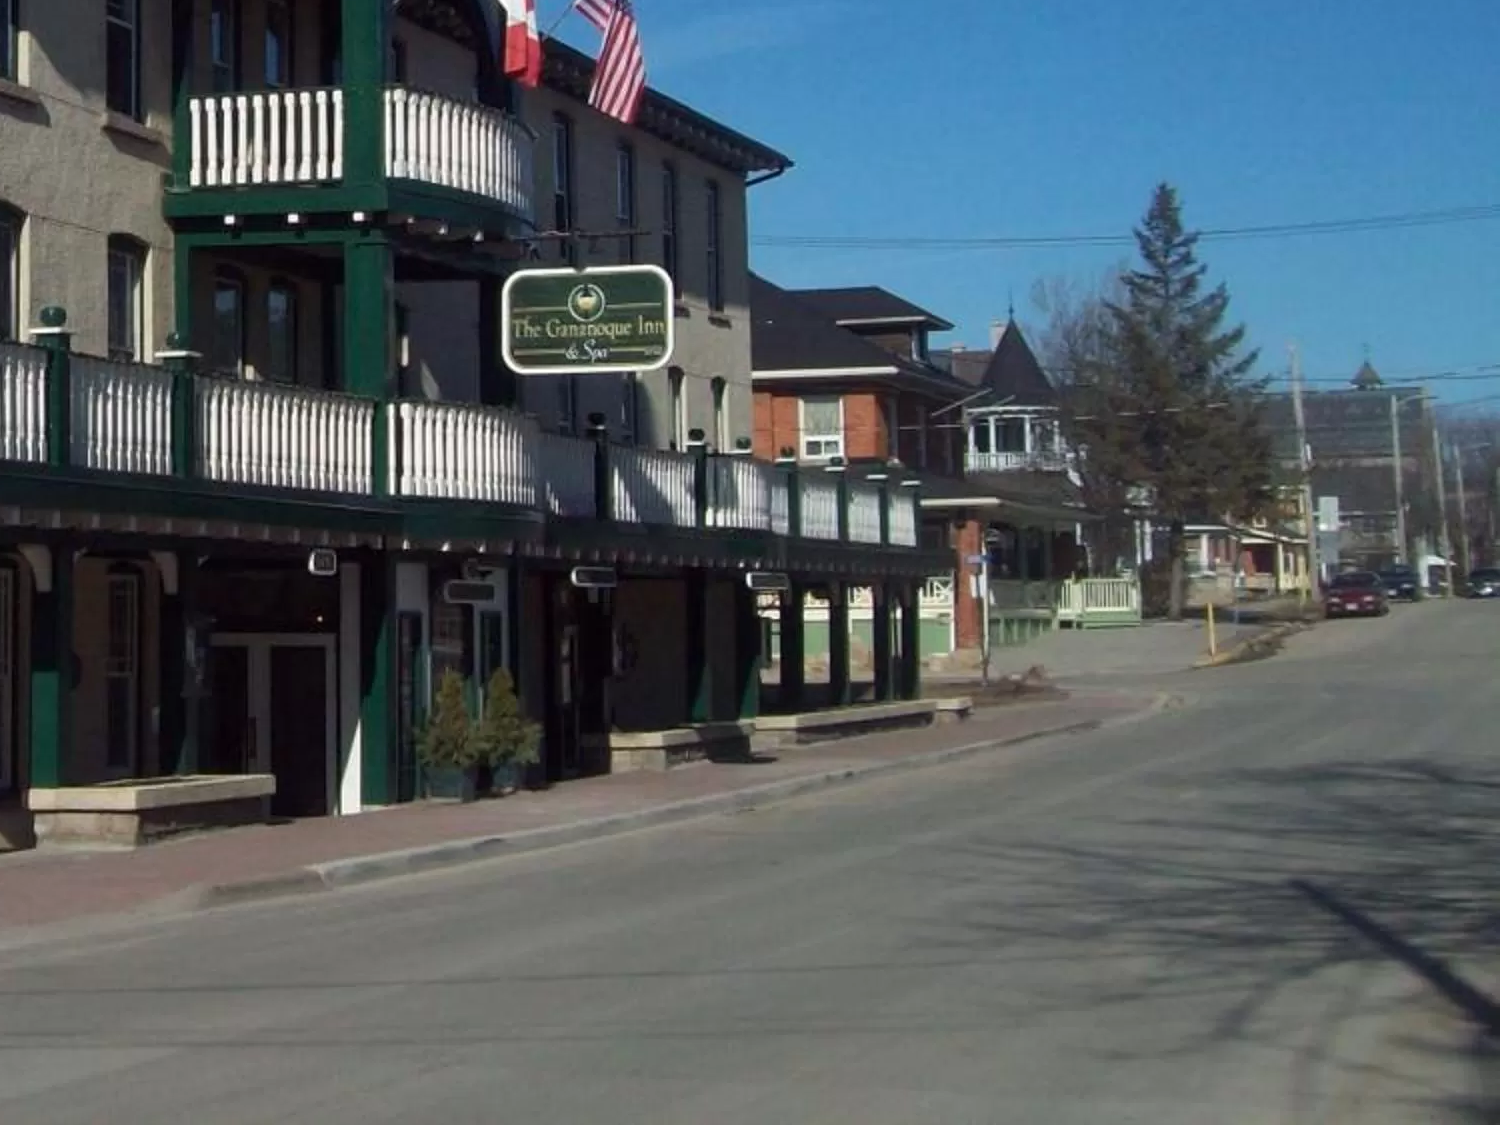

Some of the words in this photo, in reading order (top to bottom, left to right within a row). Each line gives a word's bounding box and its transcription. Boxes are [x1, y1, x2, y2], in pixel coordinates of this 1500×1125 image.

[513, 318, 540, 338] The
[546, 318, 632, 340] Gananoque
[638, 315, 666, 335] Inn
[565, 344, 579, 359] &
[583, 339, 608, 362] Spa
